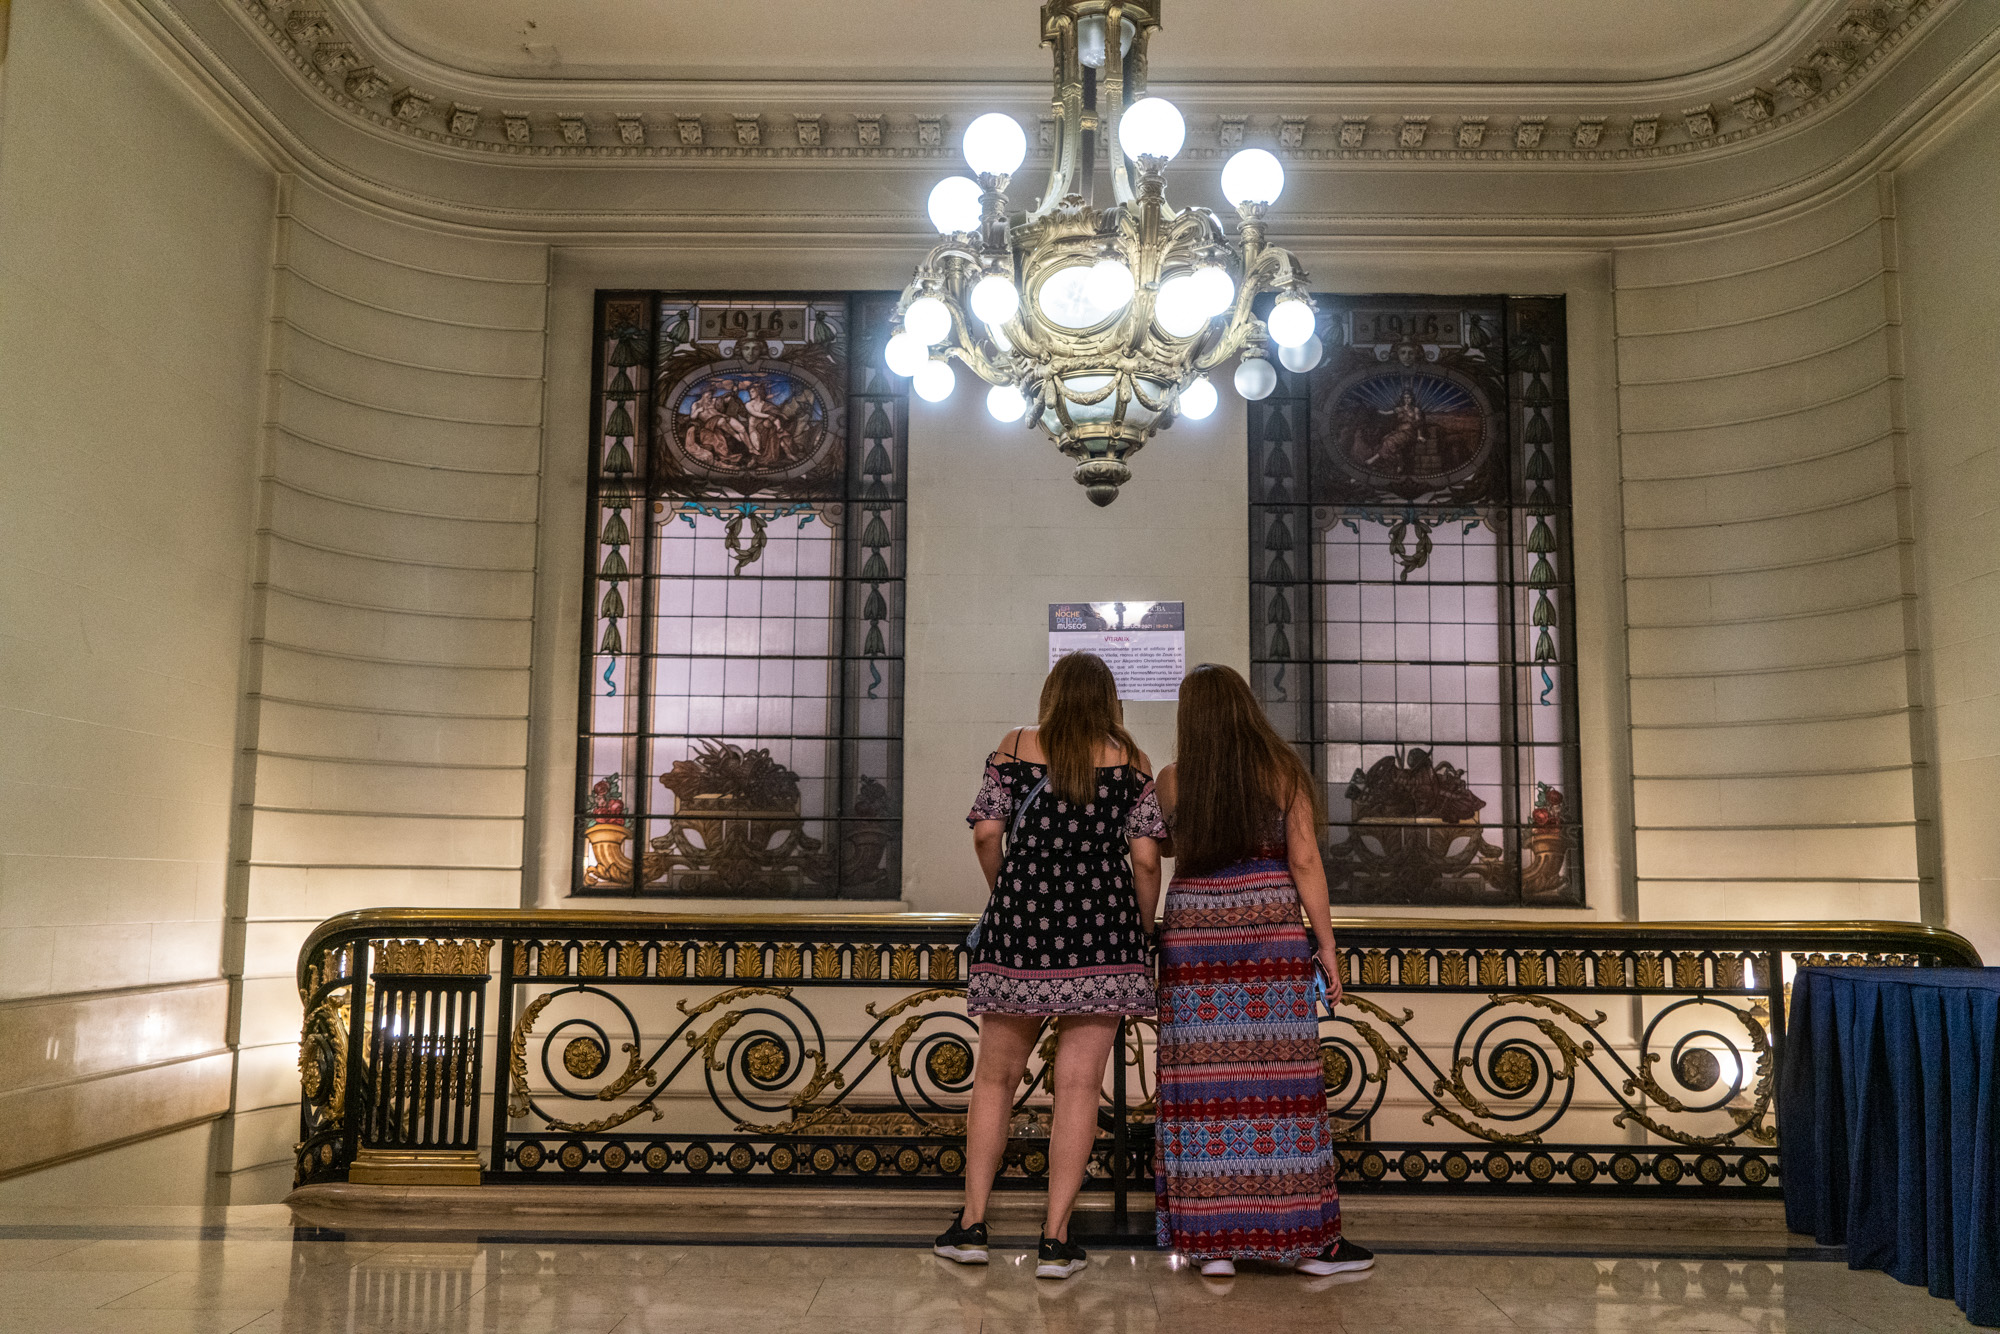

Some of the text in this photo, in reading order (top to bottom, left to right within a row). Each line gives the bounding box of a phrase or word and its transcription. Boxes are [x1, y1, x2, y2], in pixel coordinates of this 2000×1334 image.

[717, 309, 784, 336] 1916
[1372, 313, 1438, 338] 1916
[1056, 609, 1080, 618] NOCHE
[1057, 620, 1087, 630] MUSEOS
